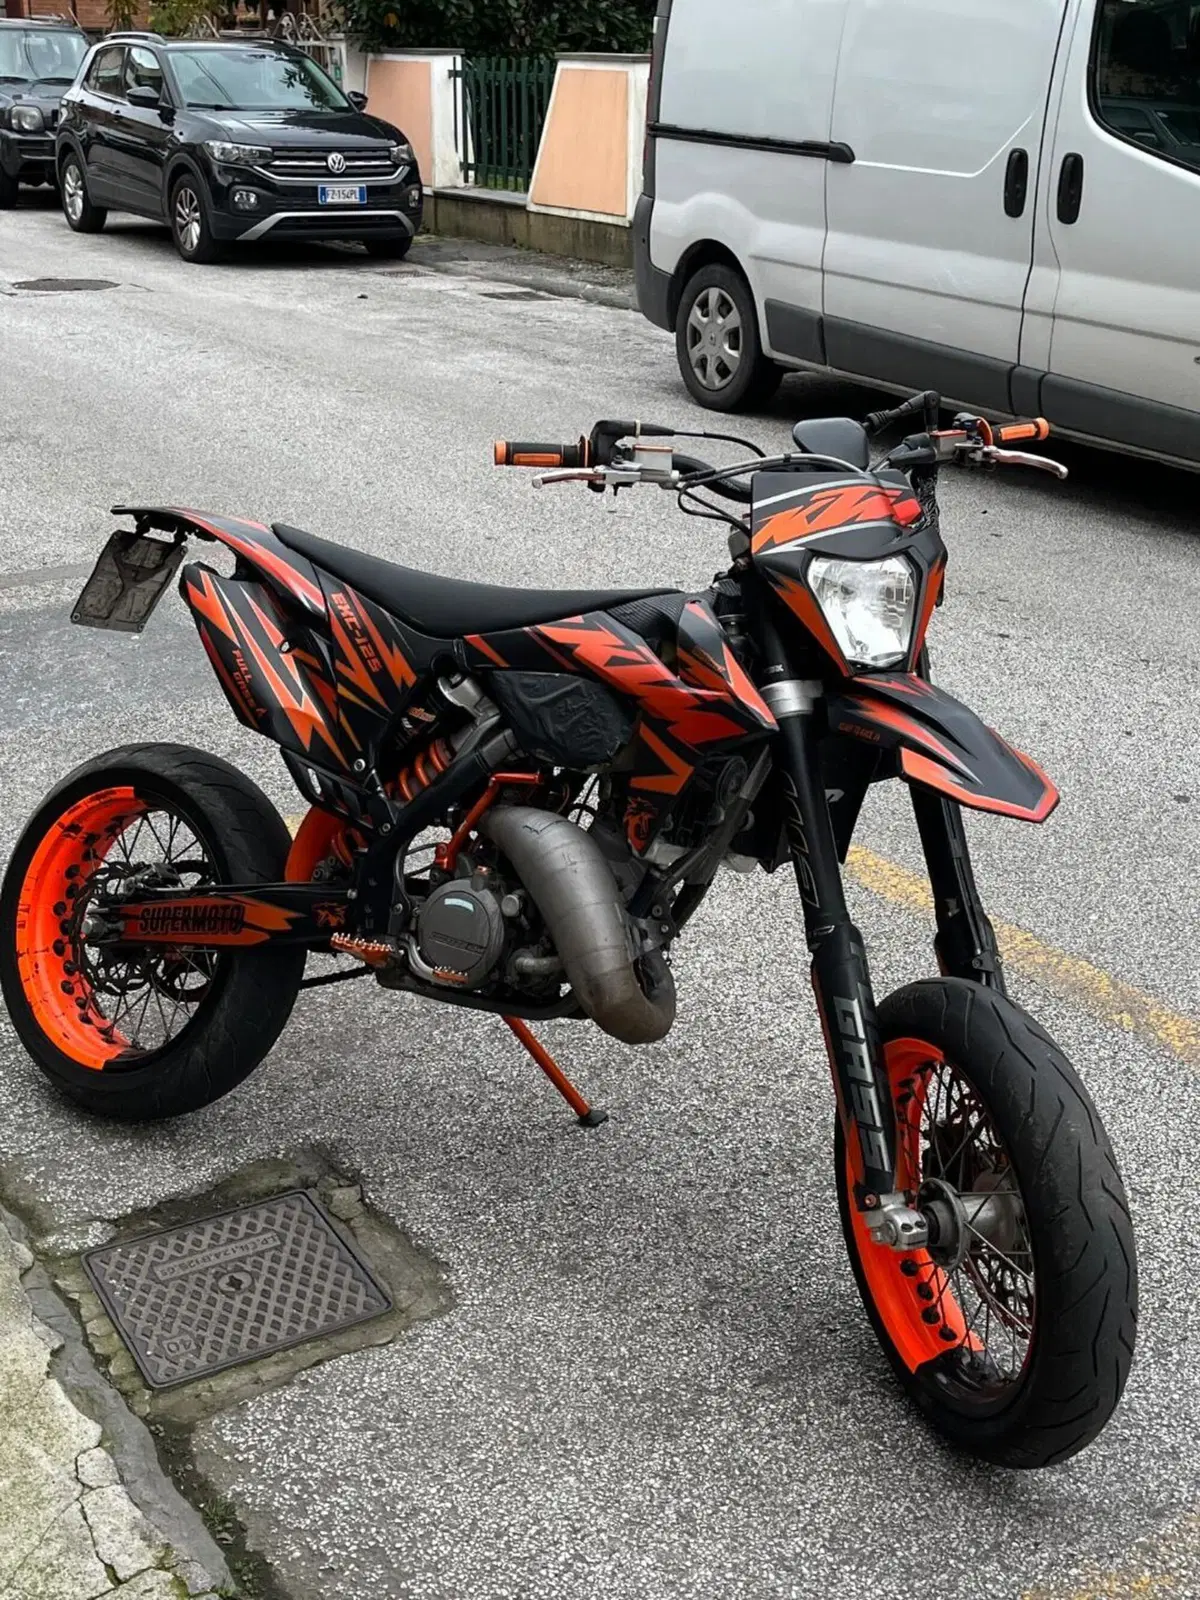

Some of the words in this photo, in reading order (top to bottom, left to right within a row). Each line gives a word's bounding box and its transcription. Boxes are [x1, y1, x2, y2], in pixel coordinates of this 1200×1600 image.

[331, 592, 383, 673] EXC-125
[139, 904, 246, 936] SUPERMOTO
[833, 996, 892, 1173] GASS
